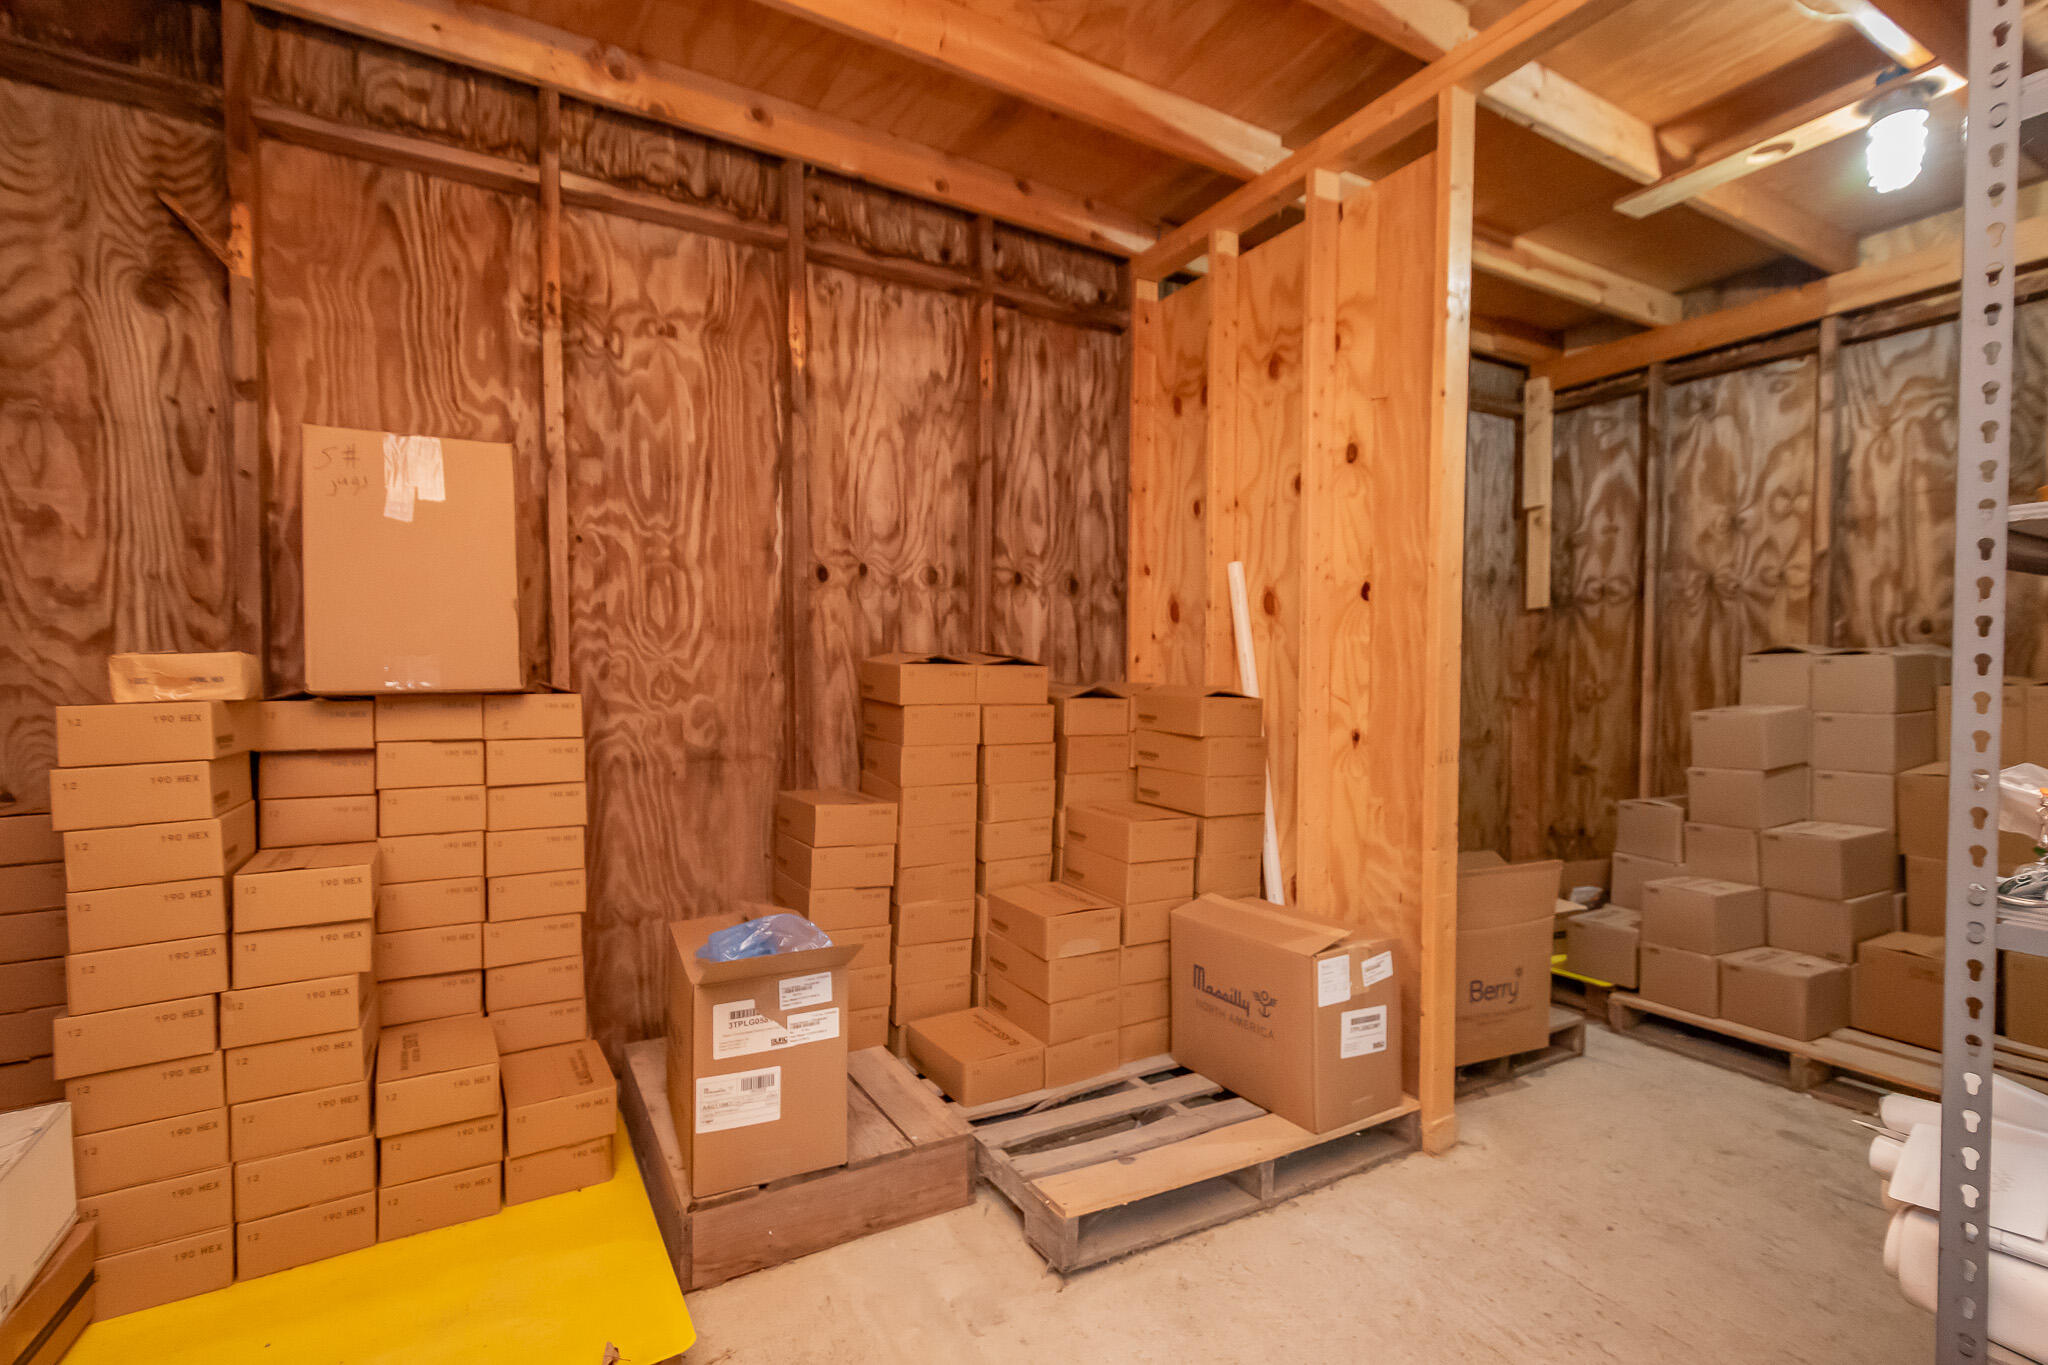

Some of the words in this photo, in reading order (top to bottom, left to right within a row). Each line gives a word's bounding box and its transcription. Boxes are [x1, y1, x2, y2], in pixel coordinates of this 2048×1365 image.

[153, 715, 174, 724] 190
[180, 713, 202, 722] HEX
[150, 775, 172, 785] 190
[177, 774, 199, 783] HEX
[161, 833, 182, 843] 190
[187, 831, 209, 840] HEX
[320, 878, 339, 887] 190
[343, 876, 363, 885] HEX
[164, 891, 185, 901] 190
[190, 889, 212, 898] HEX
[320, 932, 339, 942] 190
[343, 930, 362, 940] HEX
[169, 951, 190, 962] 190
[195, 948, 217, 957] HEX
[306, 990, 325, 1000] 190
[330, 988, 350, 996] HEX
[1470, 980, 1519, 1004] Berry
[155, 1013, 176, 1023] 190
[182, 1009, 204, 1019] HEX
[311, 1043, 329, 1053] 190
[333, 1040, 353, 1050] HEX
[162, 1070, 183, 1080] 190
[190, 1064, 210, 1075] HEX
[317, 1098, 336, 1109] 190
[340, 1094, 360, 1104] HEX
[170, 1127, 192, 1137] 190
[197, 1121, 218, 1132] HEX
[322, 1153, 341, 1165] 190
[346, 1150, 365, 1159] HEX
[172, 1187, 192, 1198] 190
[199, 1181, 219, 1192] HEX
[323, 1210, 342, 1221] 190
[346, 1206, 365, 1216] HEX
[175, 1250, 195, 1261] 190
[201, 1243, 223, 1254] HEX
